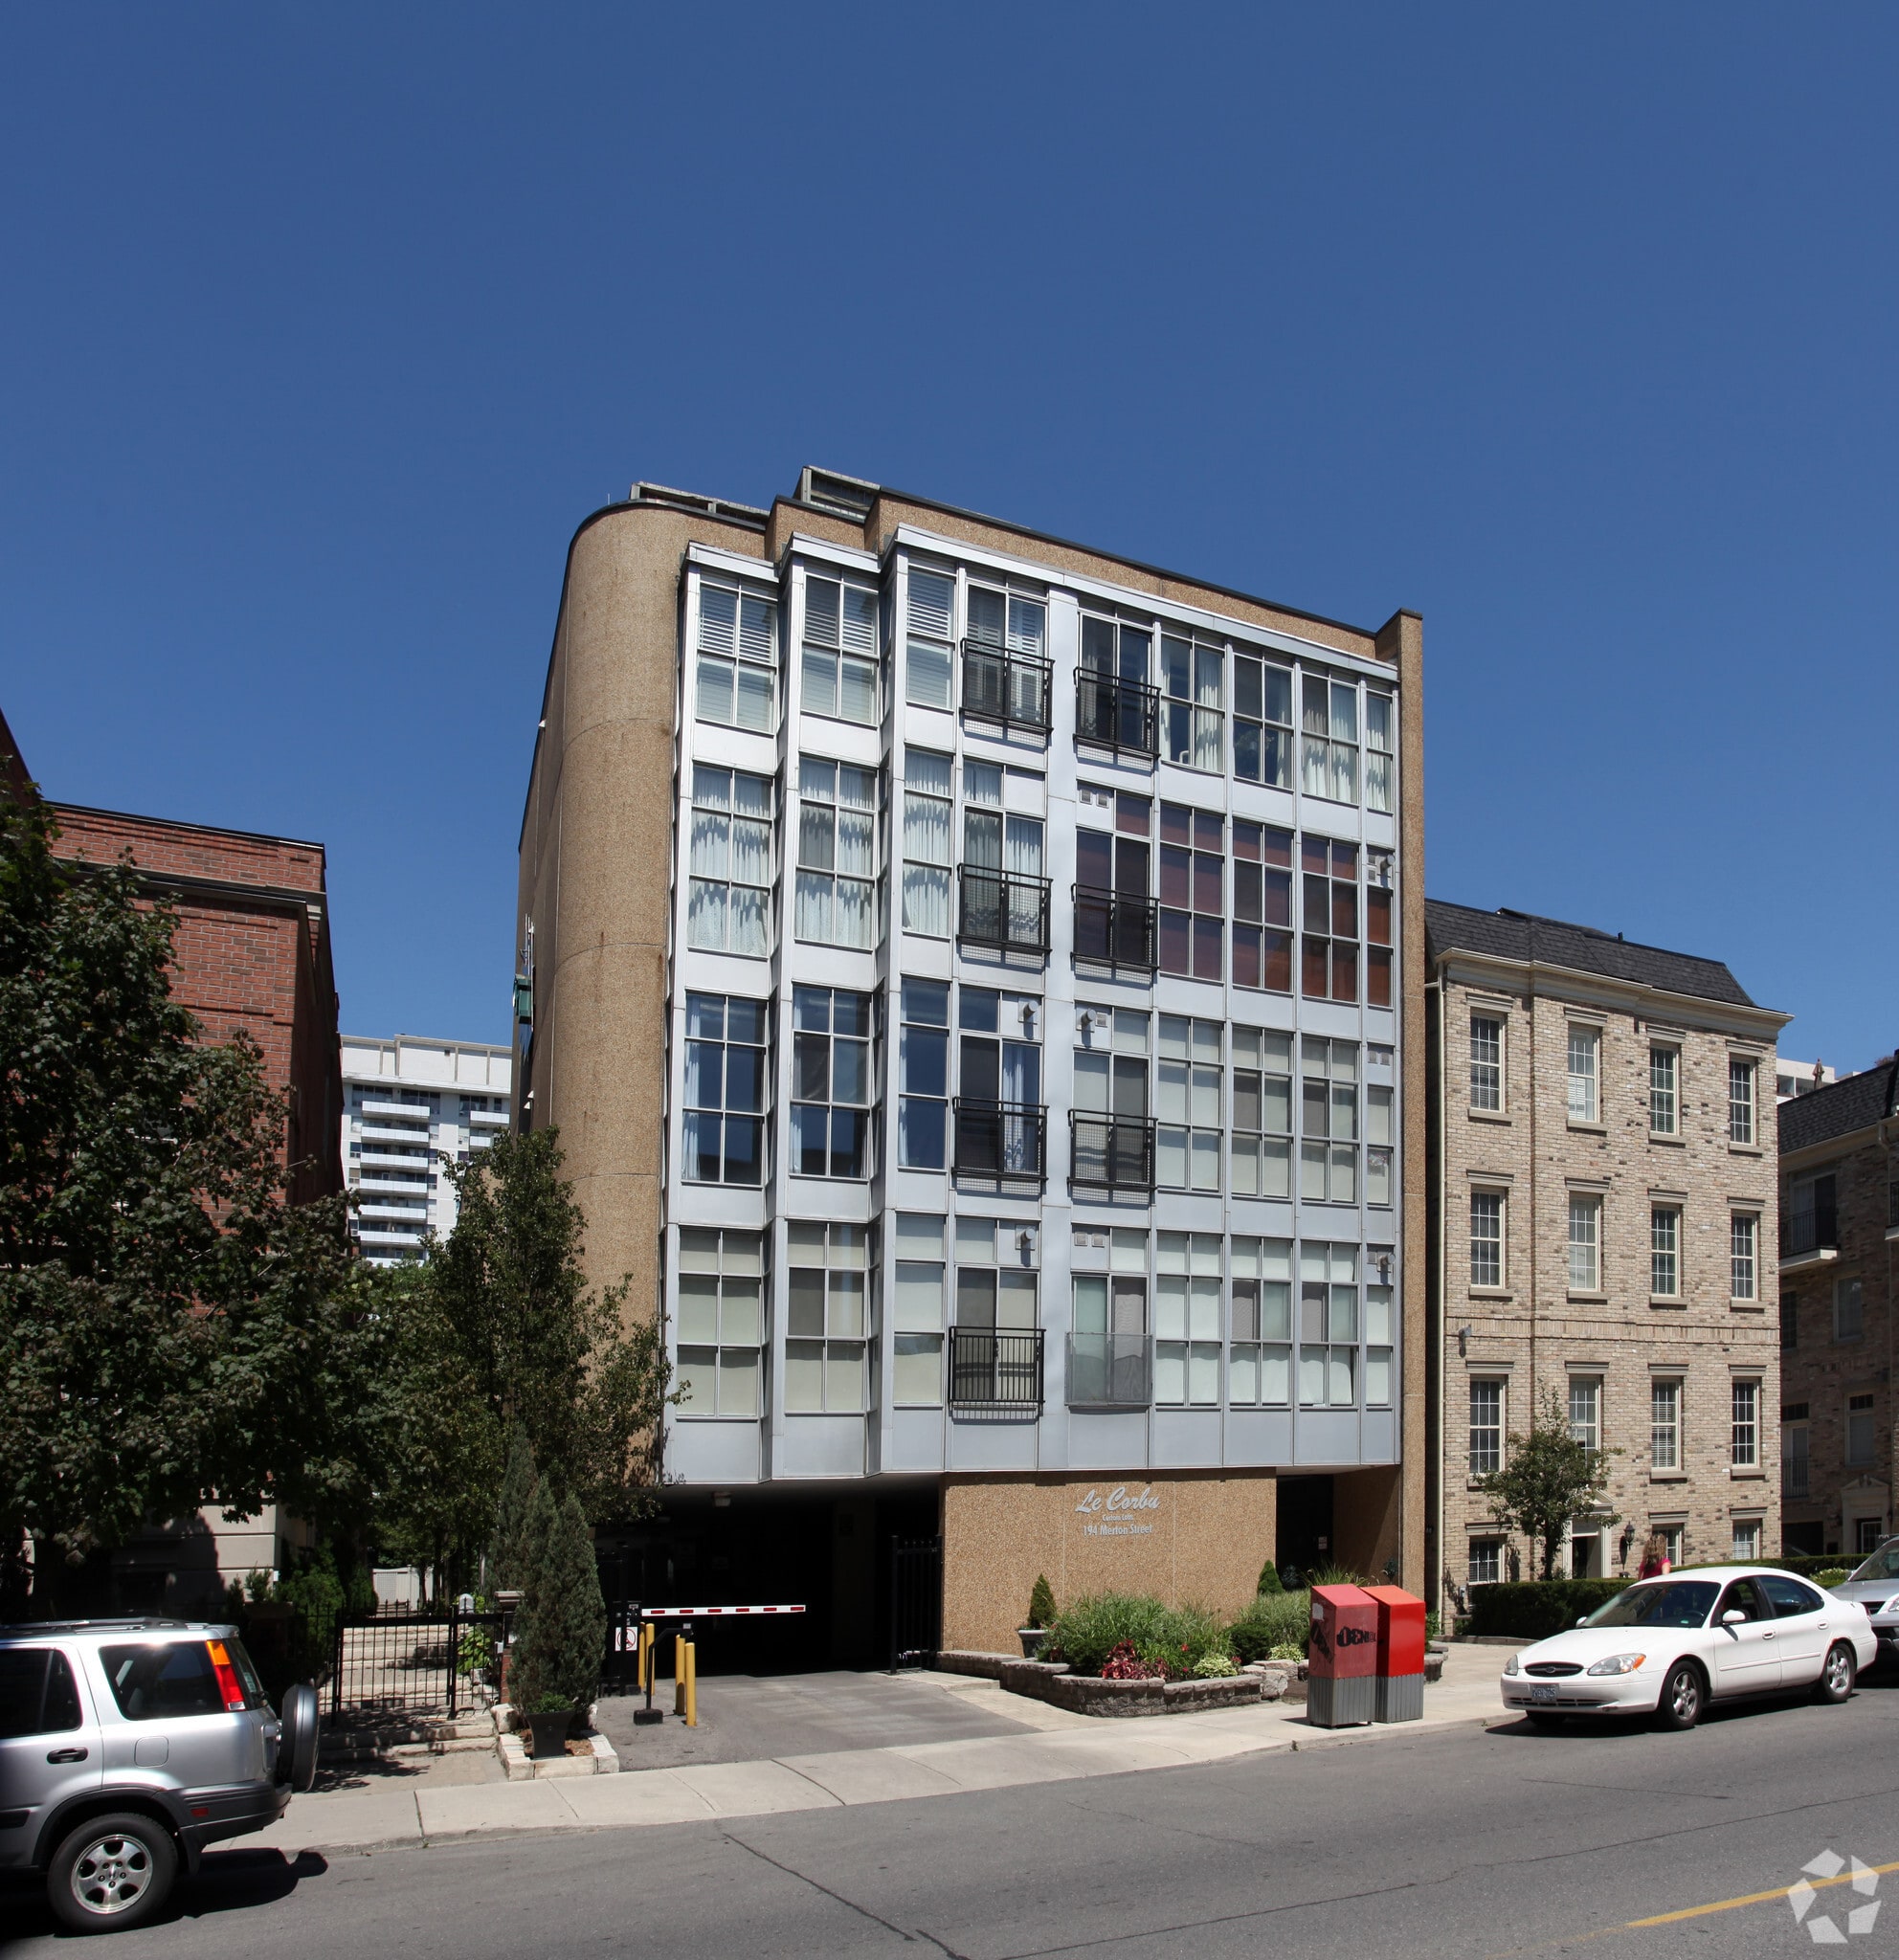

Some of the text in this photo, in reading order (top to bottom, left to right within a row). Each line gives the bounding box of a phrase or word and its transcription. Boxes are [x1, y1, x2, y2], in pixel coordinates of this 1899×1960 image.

[1075, 1486, 1160, 1513] Le Corbu
[1084, 1524, 1152, 1535] 194 Merton Street
